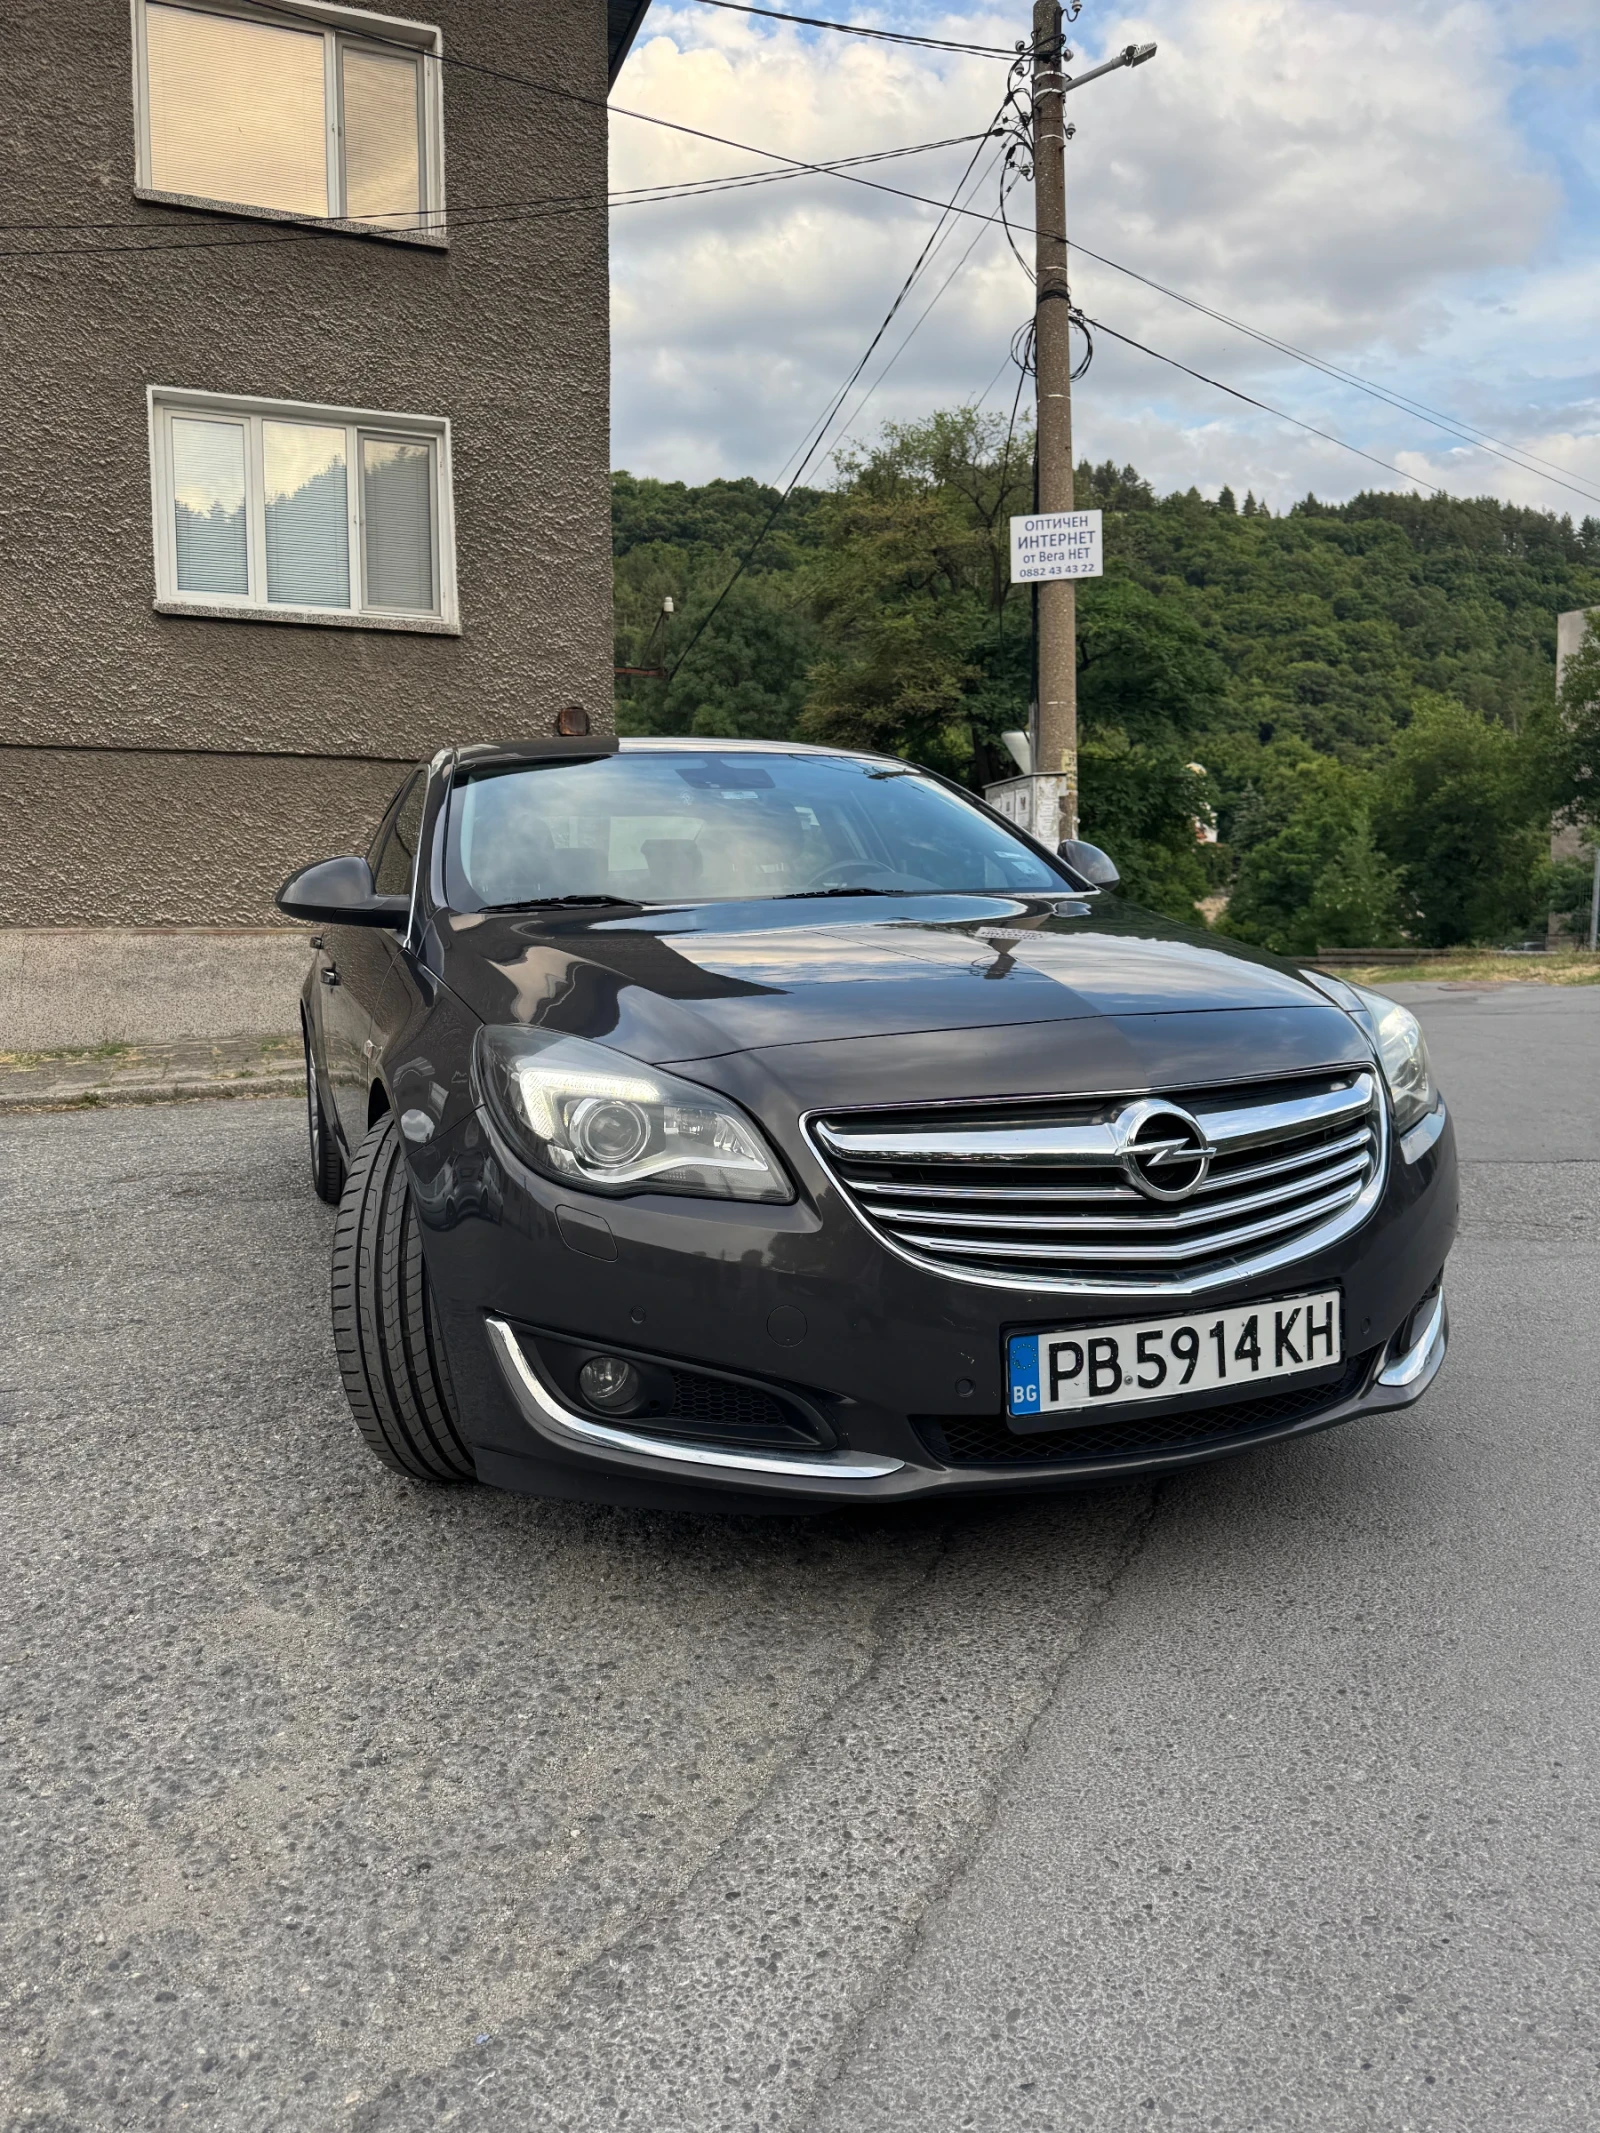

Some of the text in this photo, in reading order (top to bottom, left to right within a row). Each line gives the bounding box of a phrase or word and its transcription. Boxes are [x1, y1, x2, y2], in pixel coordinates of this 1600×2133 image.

[1025, 516, 1088, 532] ОПТИЧЕН
[1018, 530, 1096, 550] ИНТЕРНЕТ
[1023, 547, 1090, 564] от Вега НЕТ
[1019, 563, 1095, 578] 0882 43 43 22
[1013, 1384, 1037, 1404] BG
